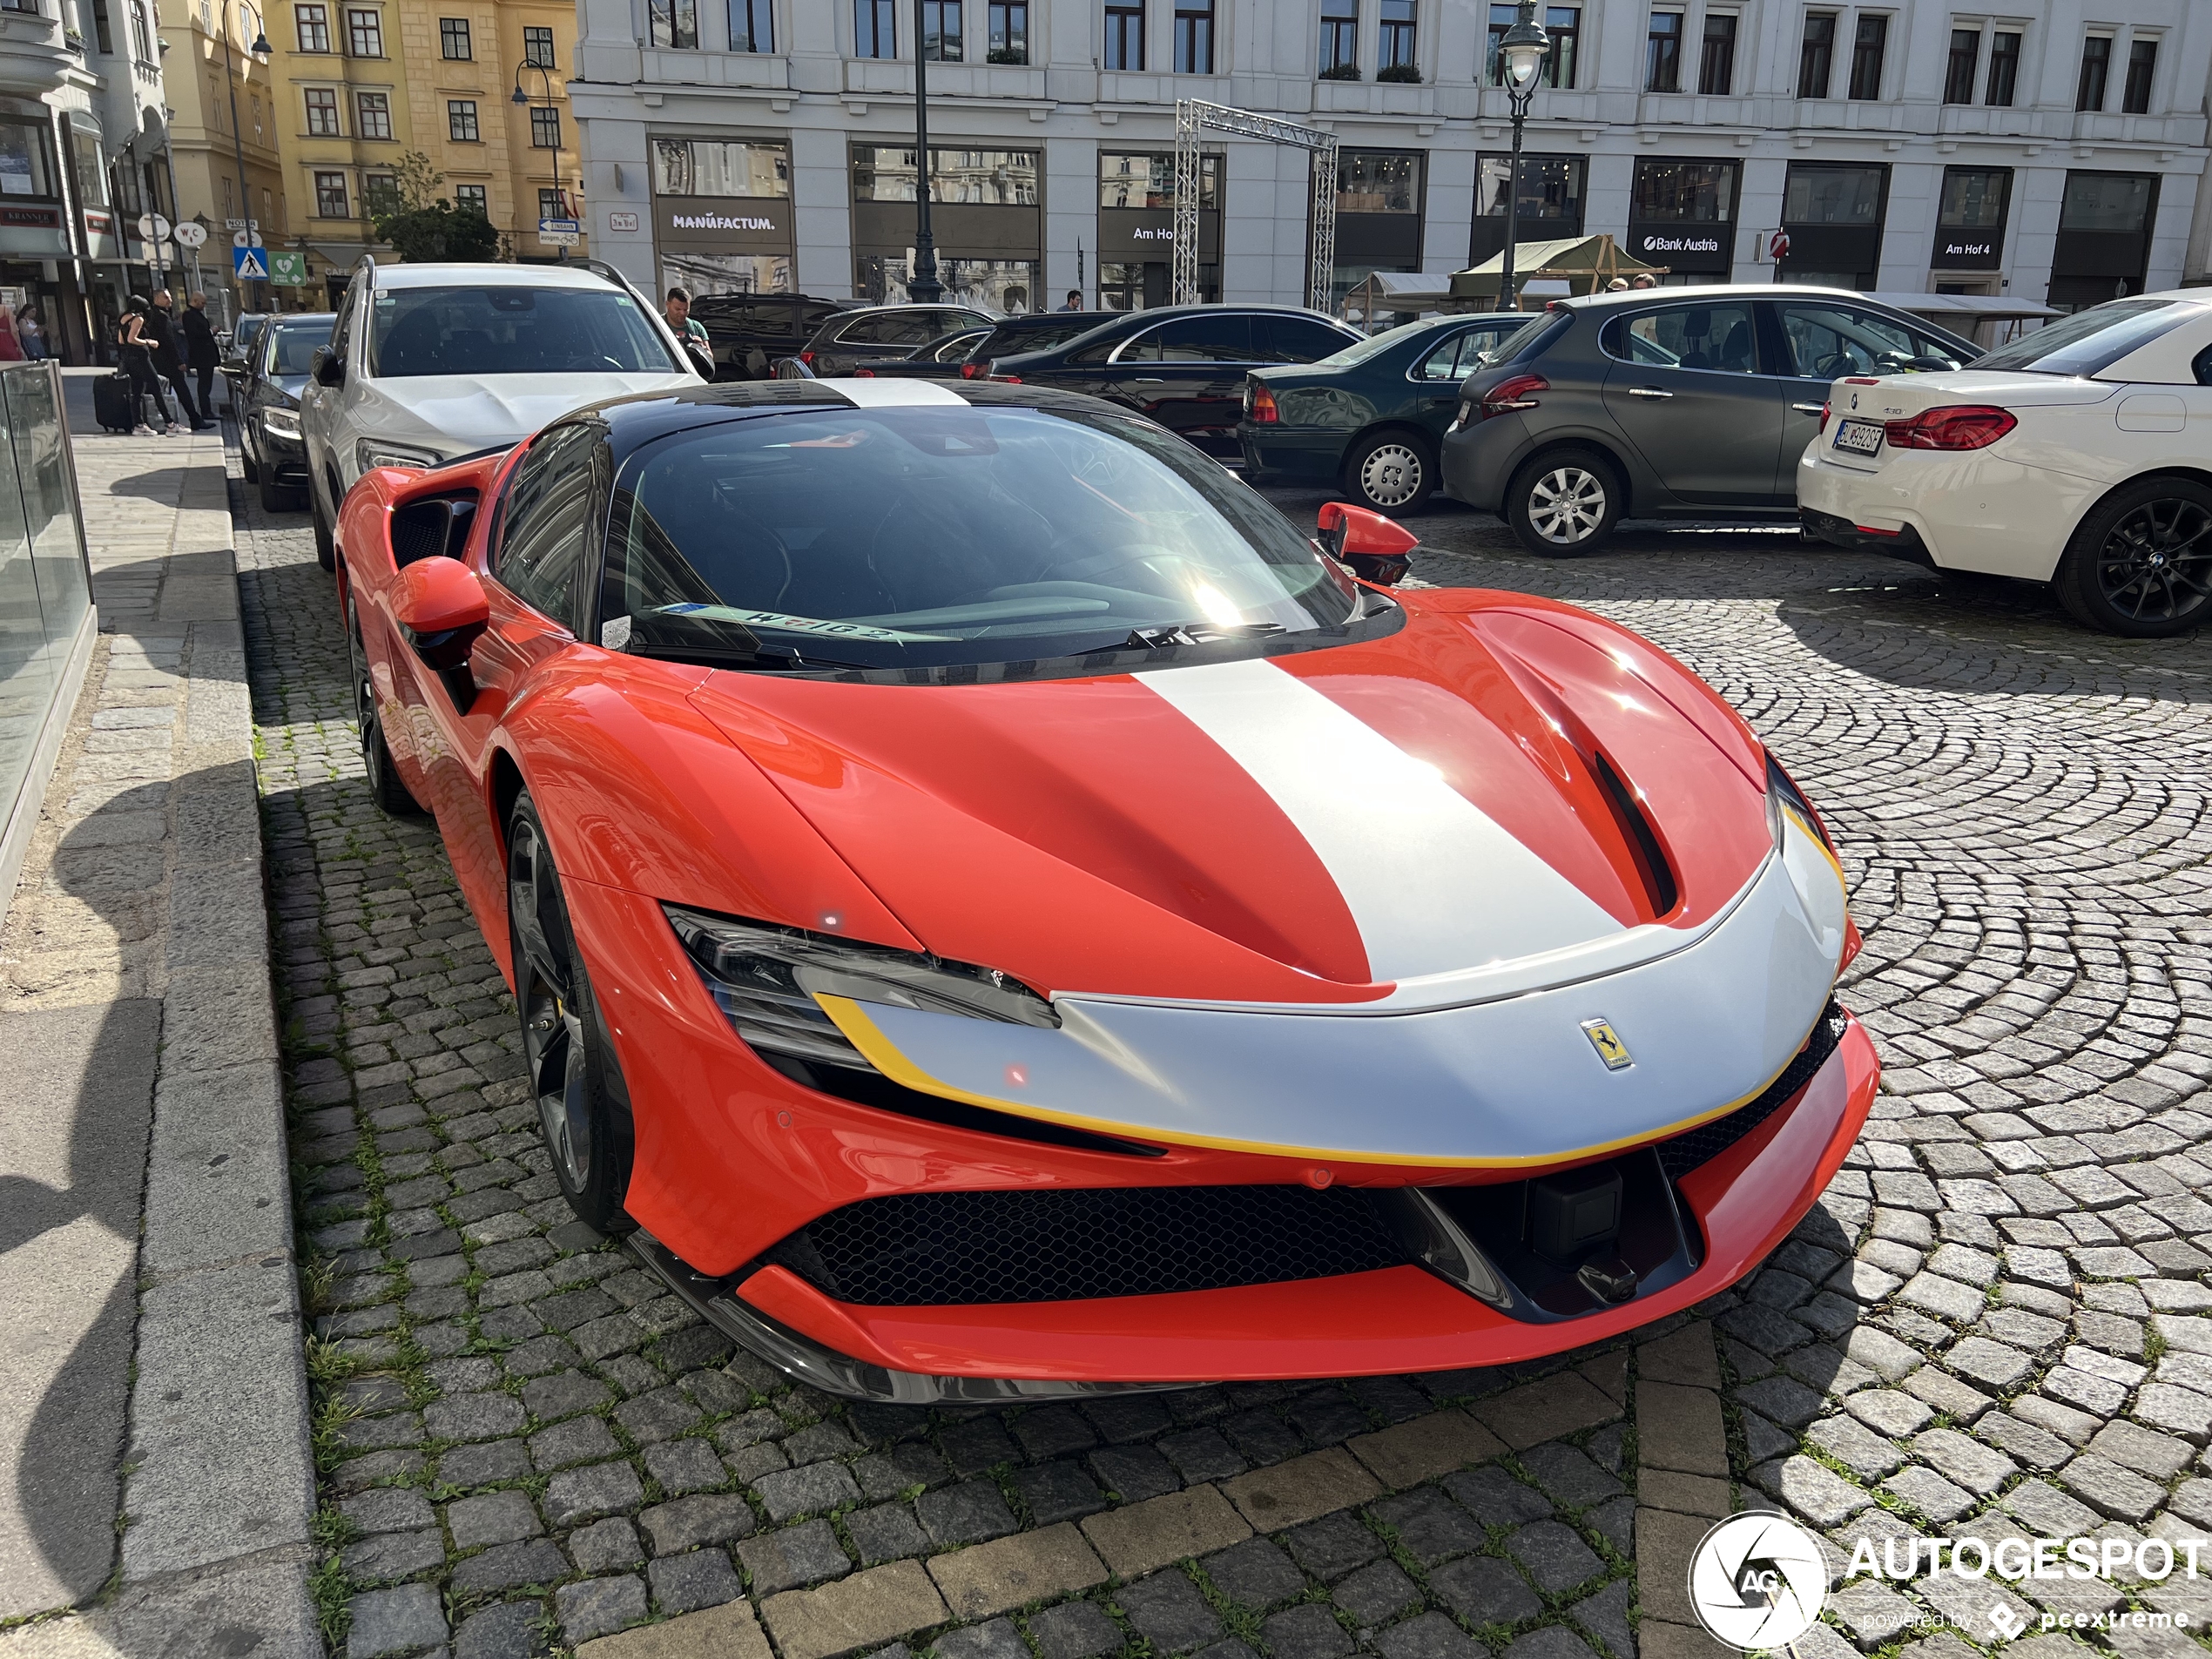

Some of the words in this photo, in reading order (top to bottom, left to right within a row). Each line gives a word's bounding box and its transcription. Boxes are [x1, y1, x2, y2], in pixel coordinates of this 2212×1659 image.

[9, 212, 50, 220] KRANNER
[1133, 227, 1154, 239] Am
[1656, 237, 1682, 251] Bank
[1683, 238, 1718, 252] Austria
[1946, 244, 1962, 254] Am
[1965, 244, 1983, 254] Hof
[1983, 244, 1990, 255] 4
